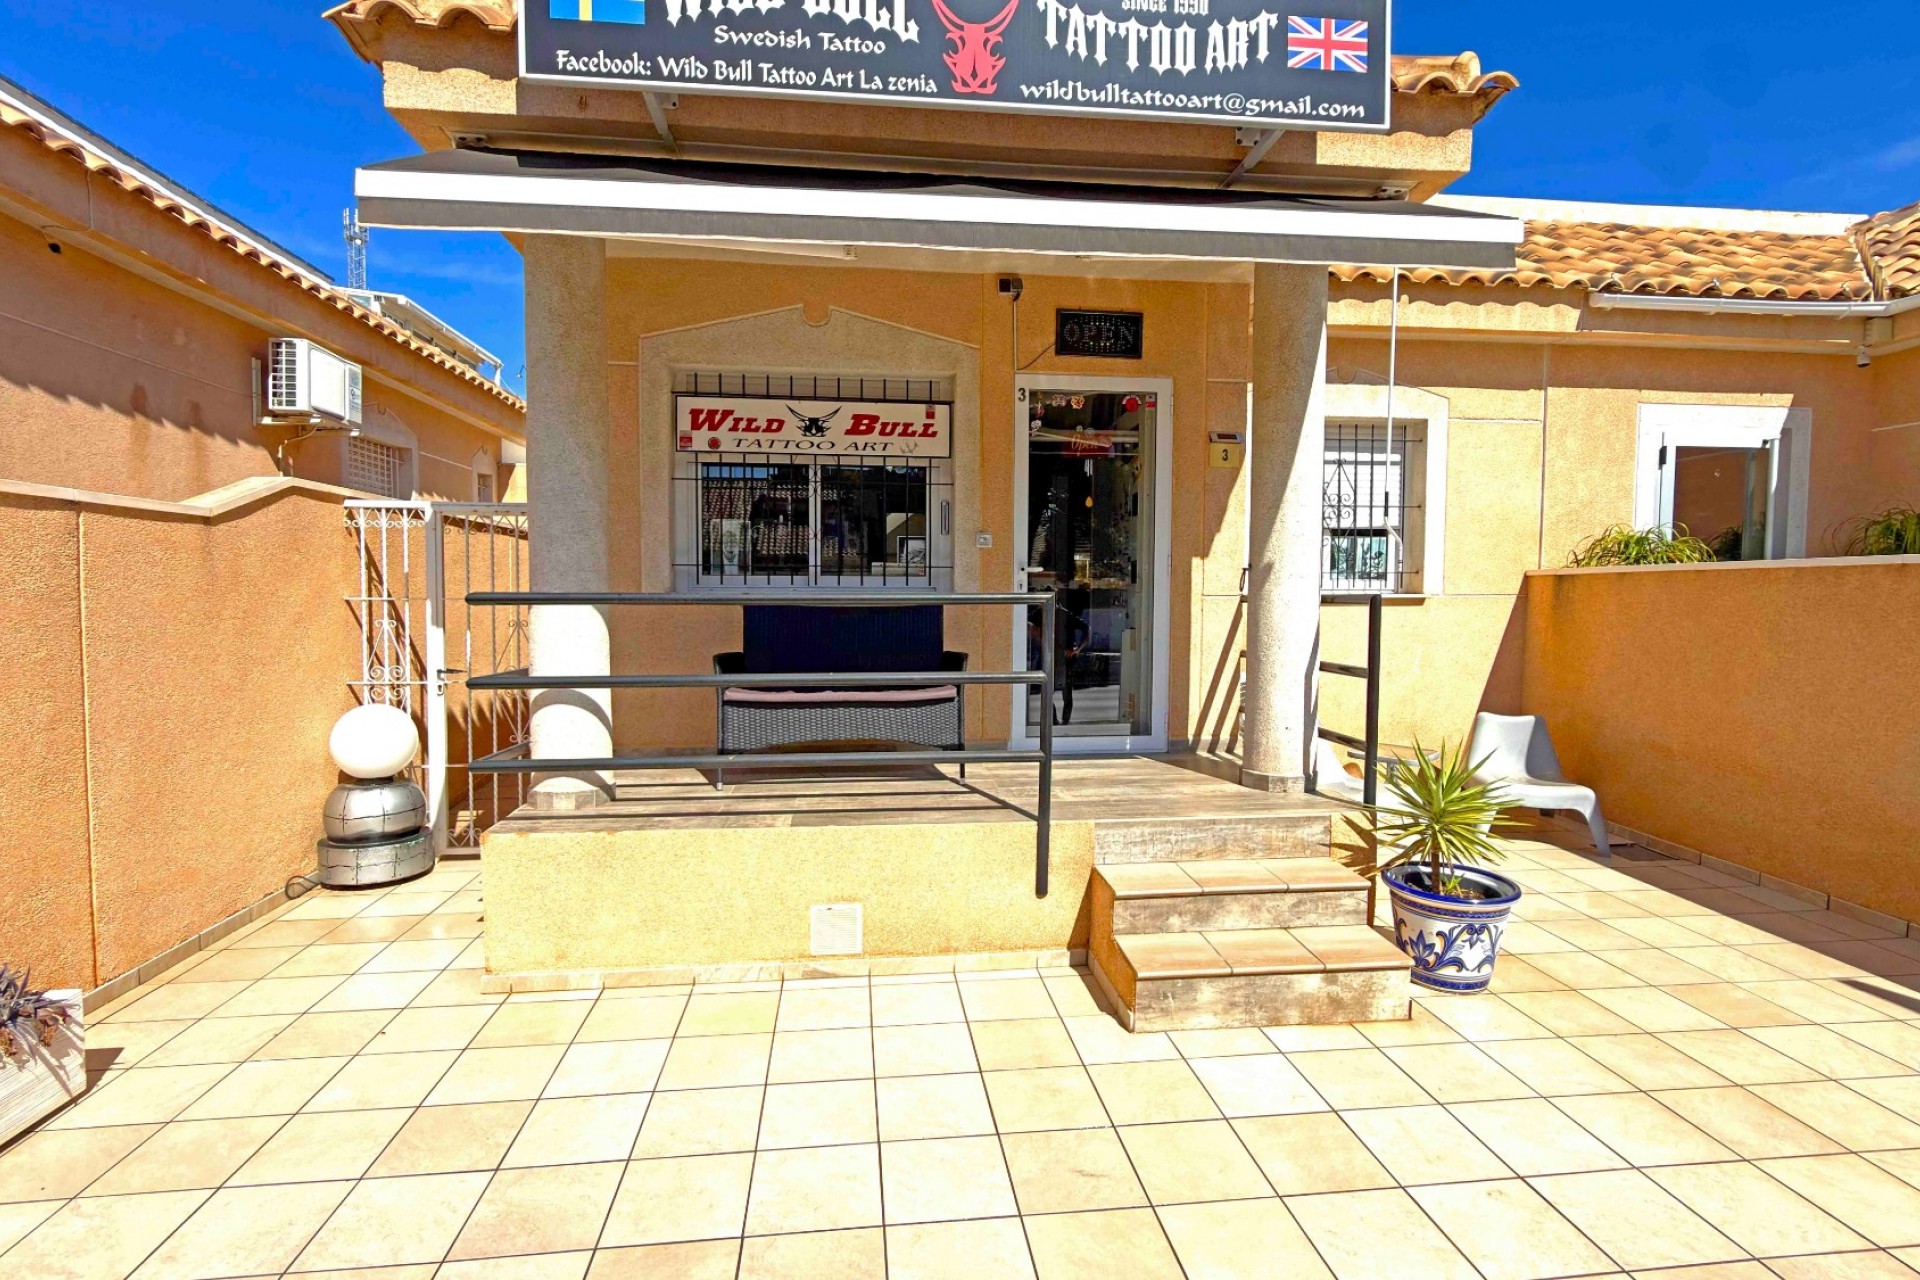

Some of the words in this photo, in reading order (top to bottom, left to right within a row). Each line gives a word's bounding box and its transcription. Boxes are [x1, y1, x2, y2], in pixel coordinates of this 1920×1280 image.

[714, 25, 811, 49] Swedish
[817, 32, 886, 55] Tattoo
[1036, 0, 1197, 77] TATTOO
[1204, 9, 1279, 75] ART
[556, 50, 652, 76] Facebook:
[656, 55, 709, 79] Wild
[713, 59, 752, 82] Bull
[757, 62, 817, 86] Tattoo
[820, 67, 855, 89] Art
[859, 68, 883, 90] La
[888, 74, 938, 93] zenia
[1019, 79, 1366, 118] wildbulltattooart@gmail.com
[1064, 321, 1136, 344] OPEN
[1018, 387, 1026, 402] 3
[688, 408, 786, 433] WILD
[844, 413, 939, 438] BULL
[732, 437, 836, 451] TATTOO
[843, 441, 894, 452] ART
[1222, 448, 1229, 461] 3
